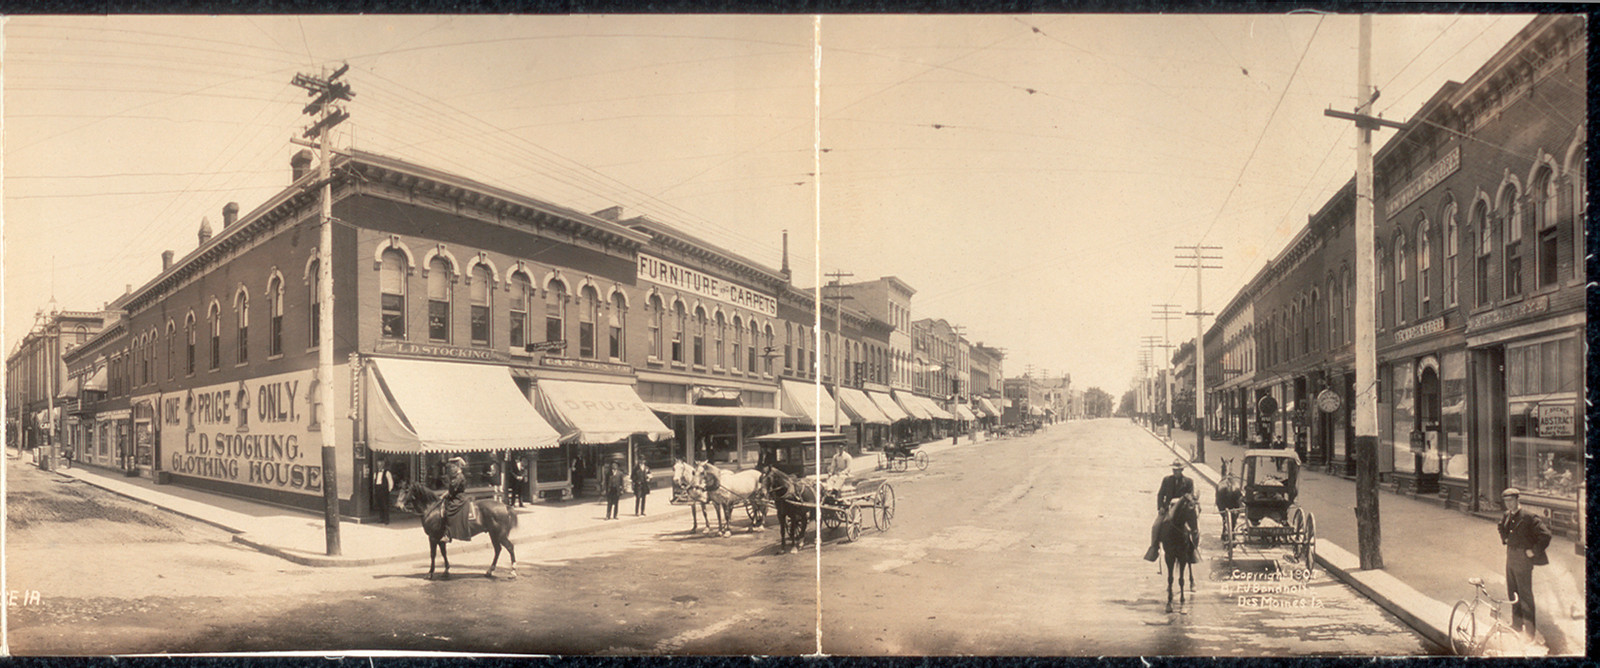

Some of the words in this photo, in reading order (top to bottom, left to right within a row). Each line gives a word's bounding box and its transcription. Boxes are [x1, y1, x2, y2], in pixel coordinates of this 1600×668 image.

[639, 256, 719, 297] FURNITURE
[730, 286, 777, 315] CARPETS
[422, 346, 491, 360] STOCKING
[164, 396, 180, 427] ONE
[198, 389, 231, 426] PRICE
[564, 399, 647, 412] DRUGS
[1540, 416, 1574, 426] ABSTRACT
[171, 451, 239, 480] CLOTHING
[249, 461, 322, 492] HOUSE
